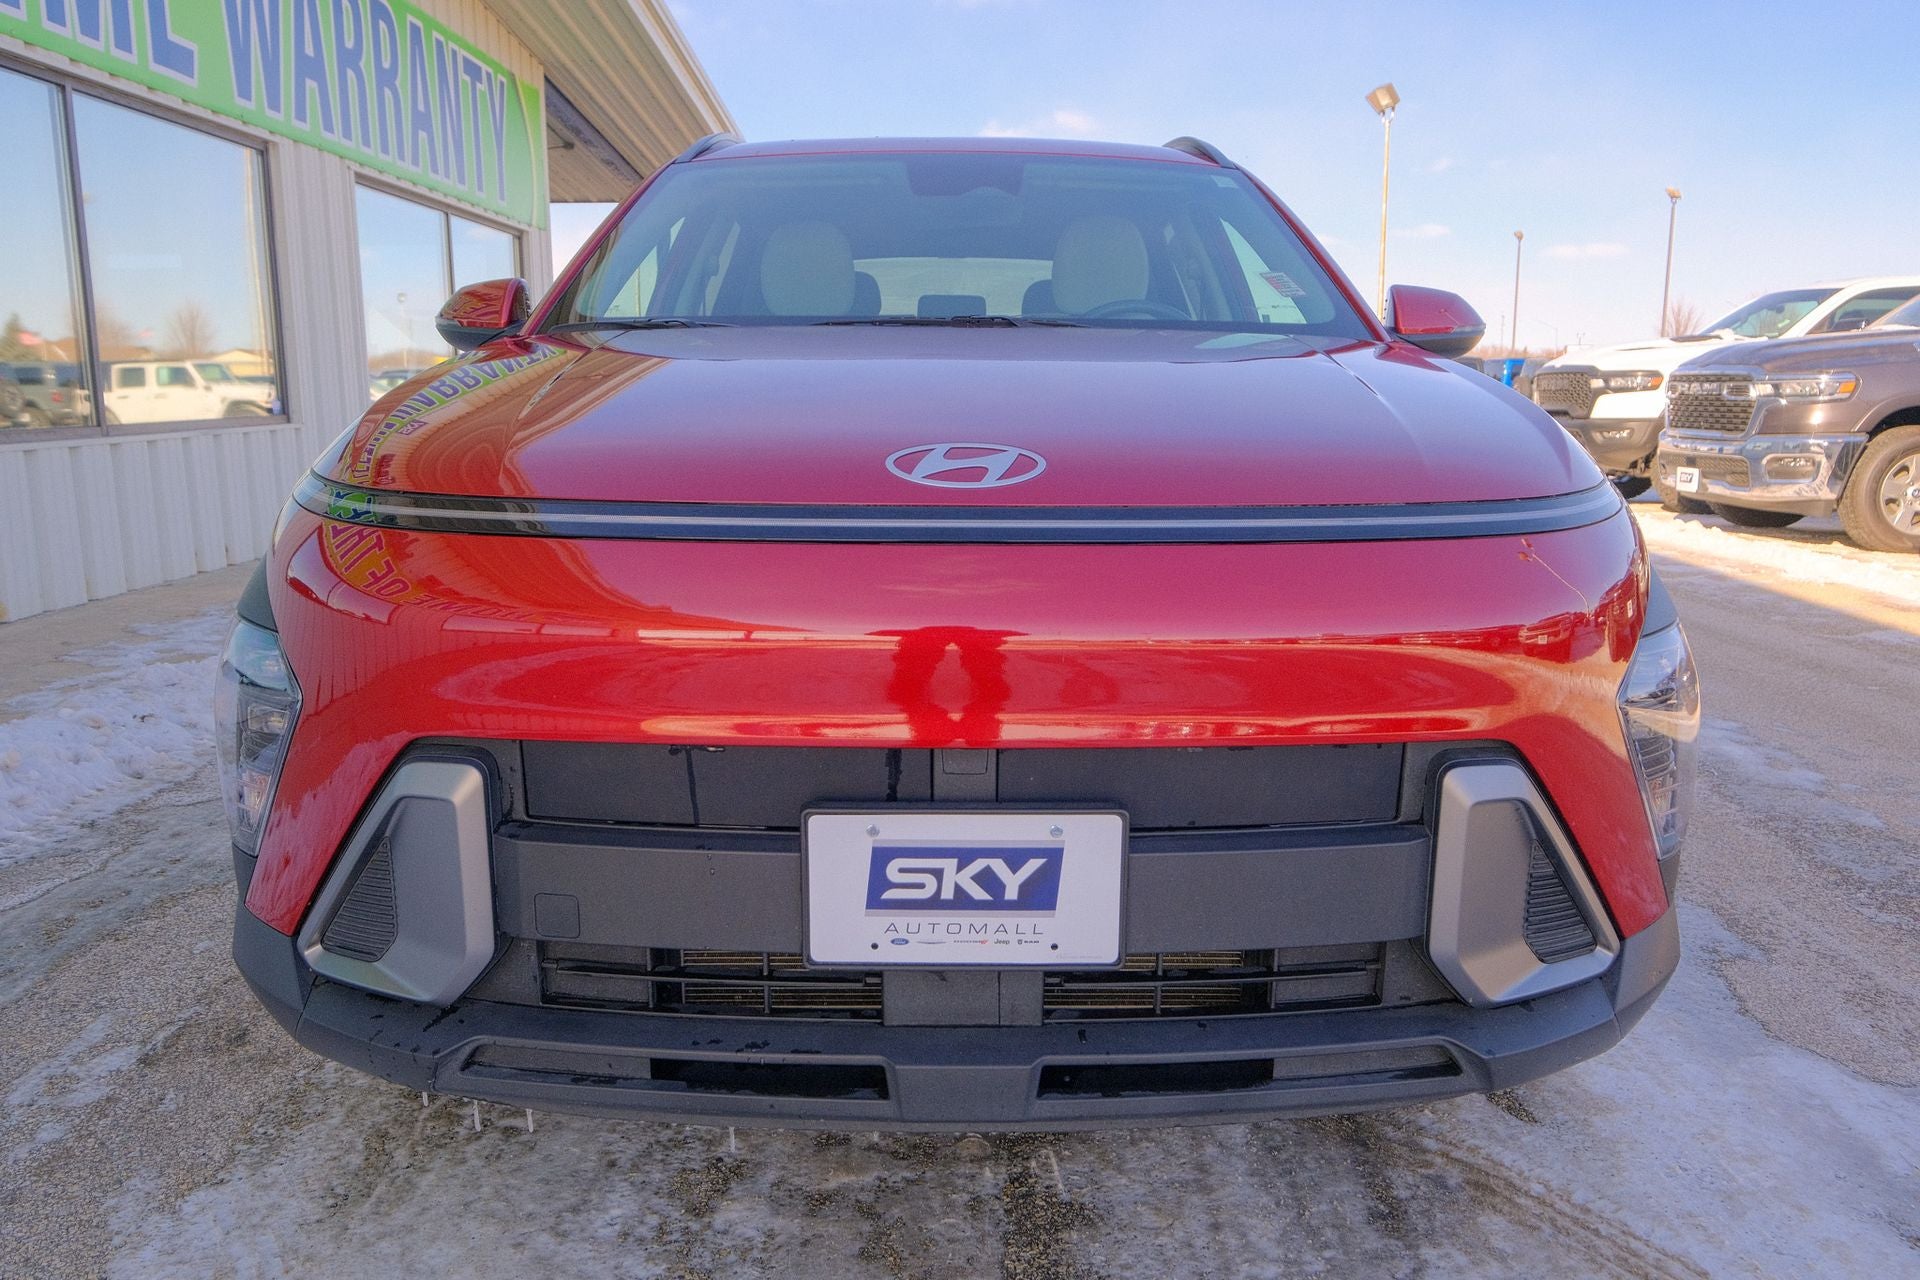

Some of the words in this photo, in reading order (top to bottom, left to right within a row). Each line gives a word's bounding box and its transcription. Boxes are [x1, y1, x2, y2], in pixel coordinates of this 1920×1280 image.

[222, 0, 508, 205] WARRANTY
[1679, 381, 1721, 395] RAM
[880, 858, 1048, 901] SKY
[884, 922, 1044, 935] AUTOMALL
